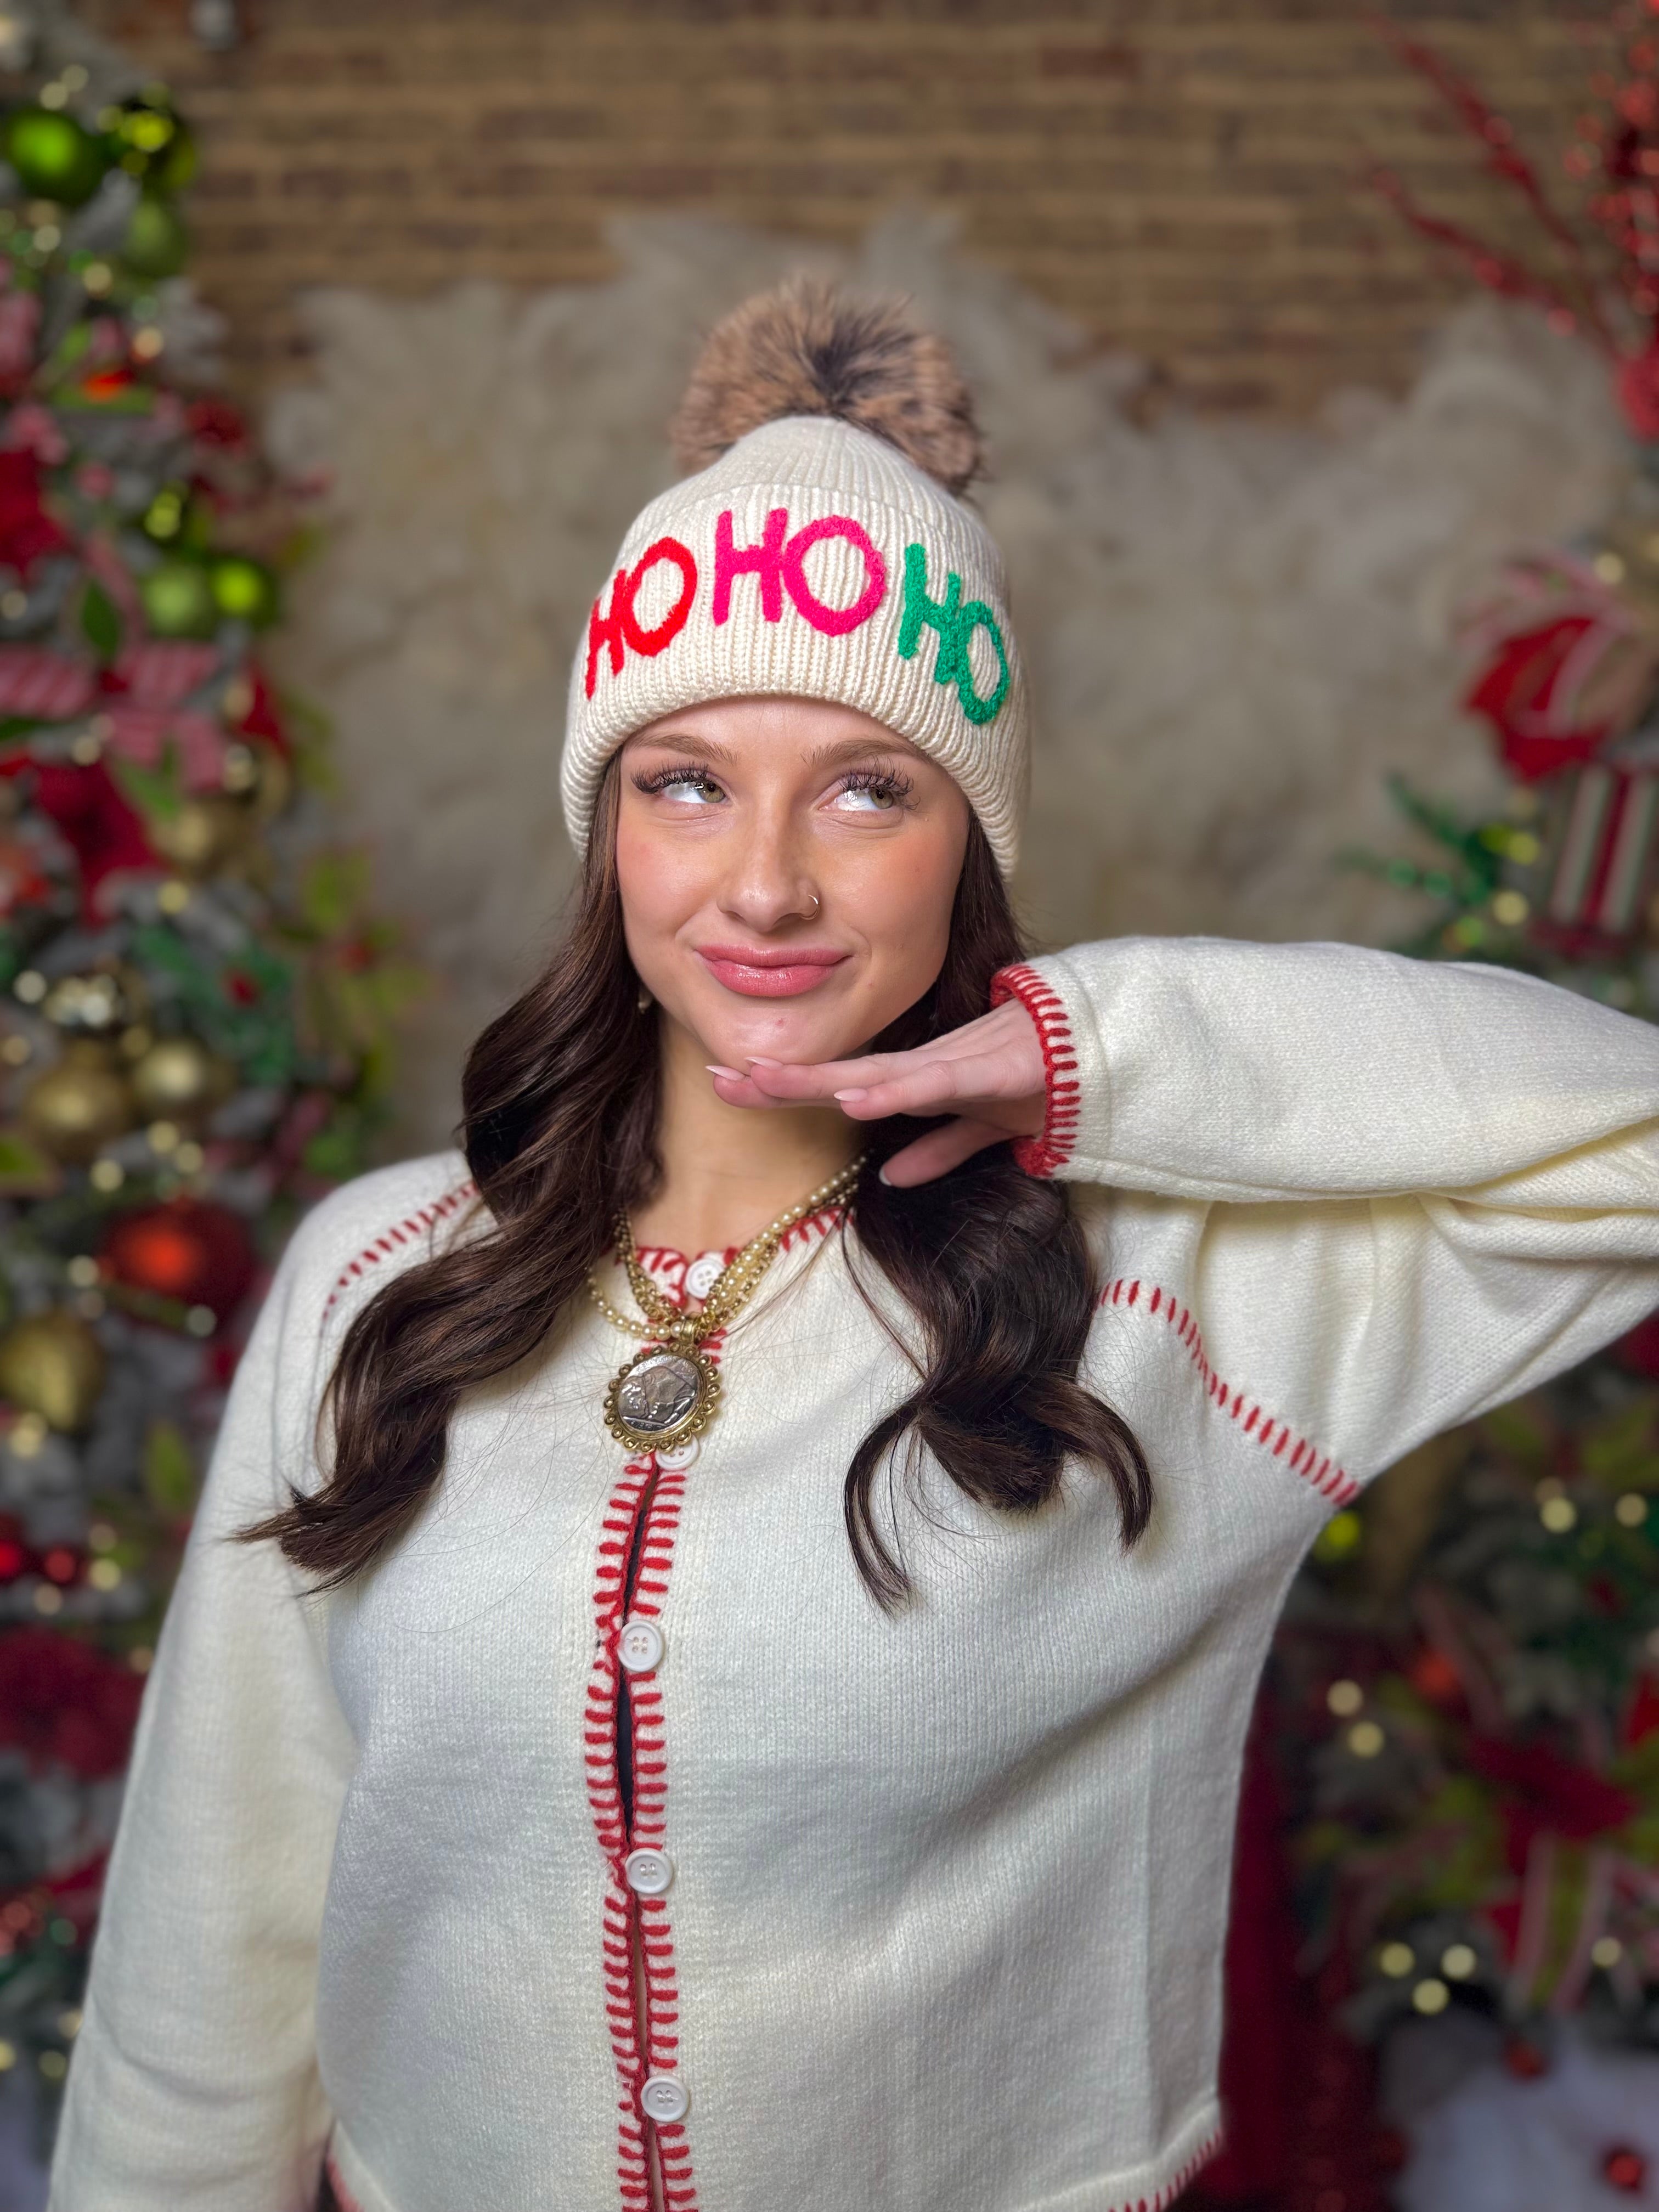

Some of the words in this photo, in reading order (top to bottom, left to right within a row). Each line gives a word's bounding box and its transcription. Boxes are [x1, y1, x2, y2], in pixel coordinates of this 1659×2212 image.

[585, 537, 698, 701] HO
[712, 507, 888, 637] HO
[898, 543, 1011, 725] HO
